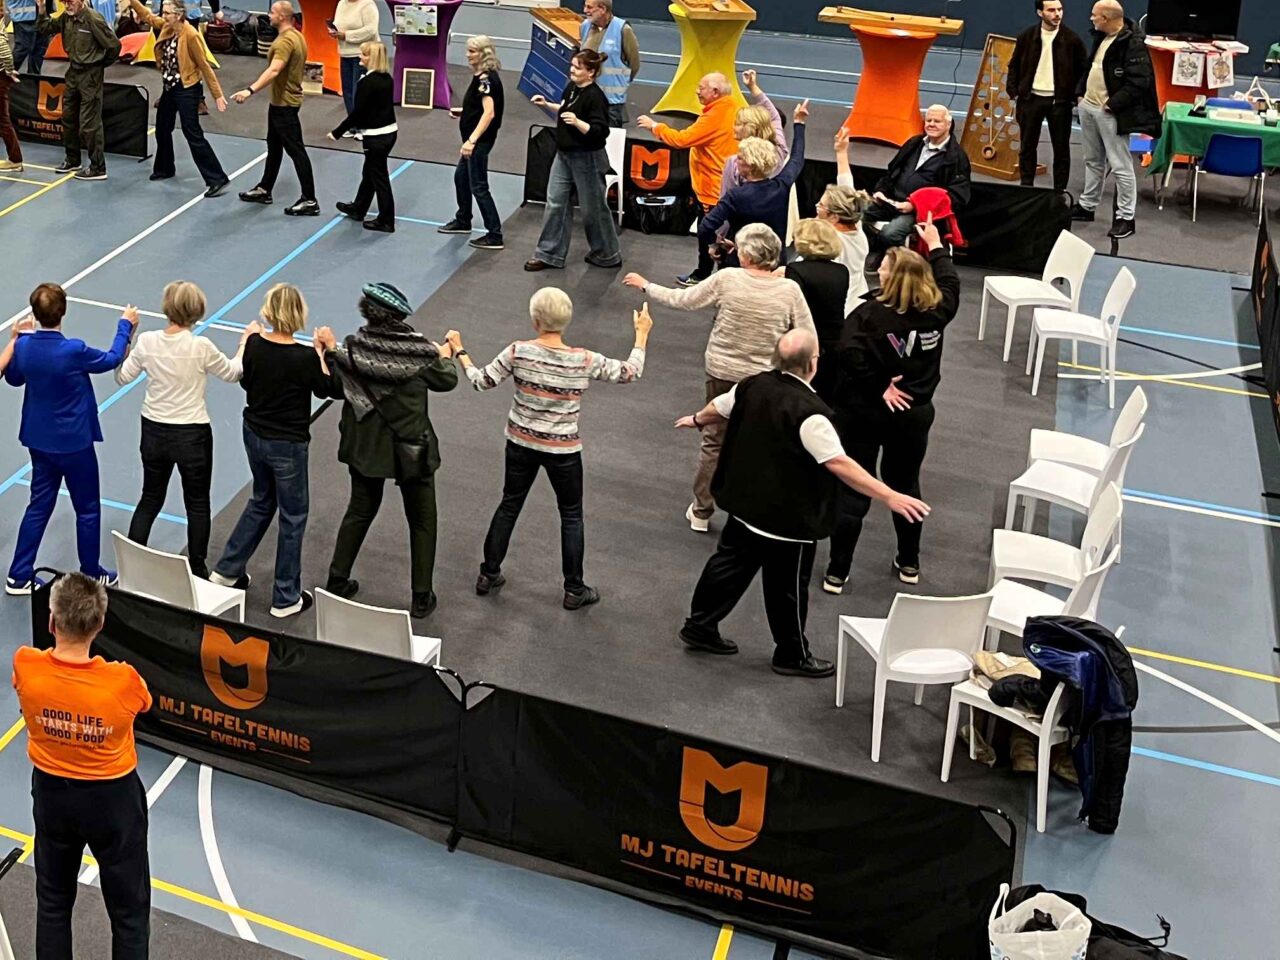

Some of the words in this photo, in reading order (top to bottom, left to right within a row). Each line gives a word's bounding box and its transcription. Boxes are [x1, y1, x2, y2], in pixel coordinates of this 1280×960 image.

[35, 715, 77, 733] STARTS
[82, 724, 114, 736] WITH
[42, 708, 72, 722] GOOD
[77, 714, 103, 727] LIFE
[159, 695, 185, 716] MJ
[190, 703, 311, 752] TAFELTENNIS
[43, 725, 71, 739] GOOD
[75, 732, 105, 744] FOOD
[210, 730, 257, 751] EVENTS
[621, 833, 654, 858] MJ
[661, 843, 815, 902] TAFELTENNIS
[685, 875, 743, 901] EVENTS
